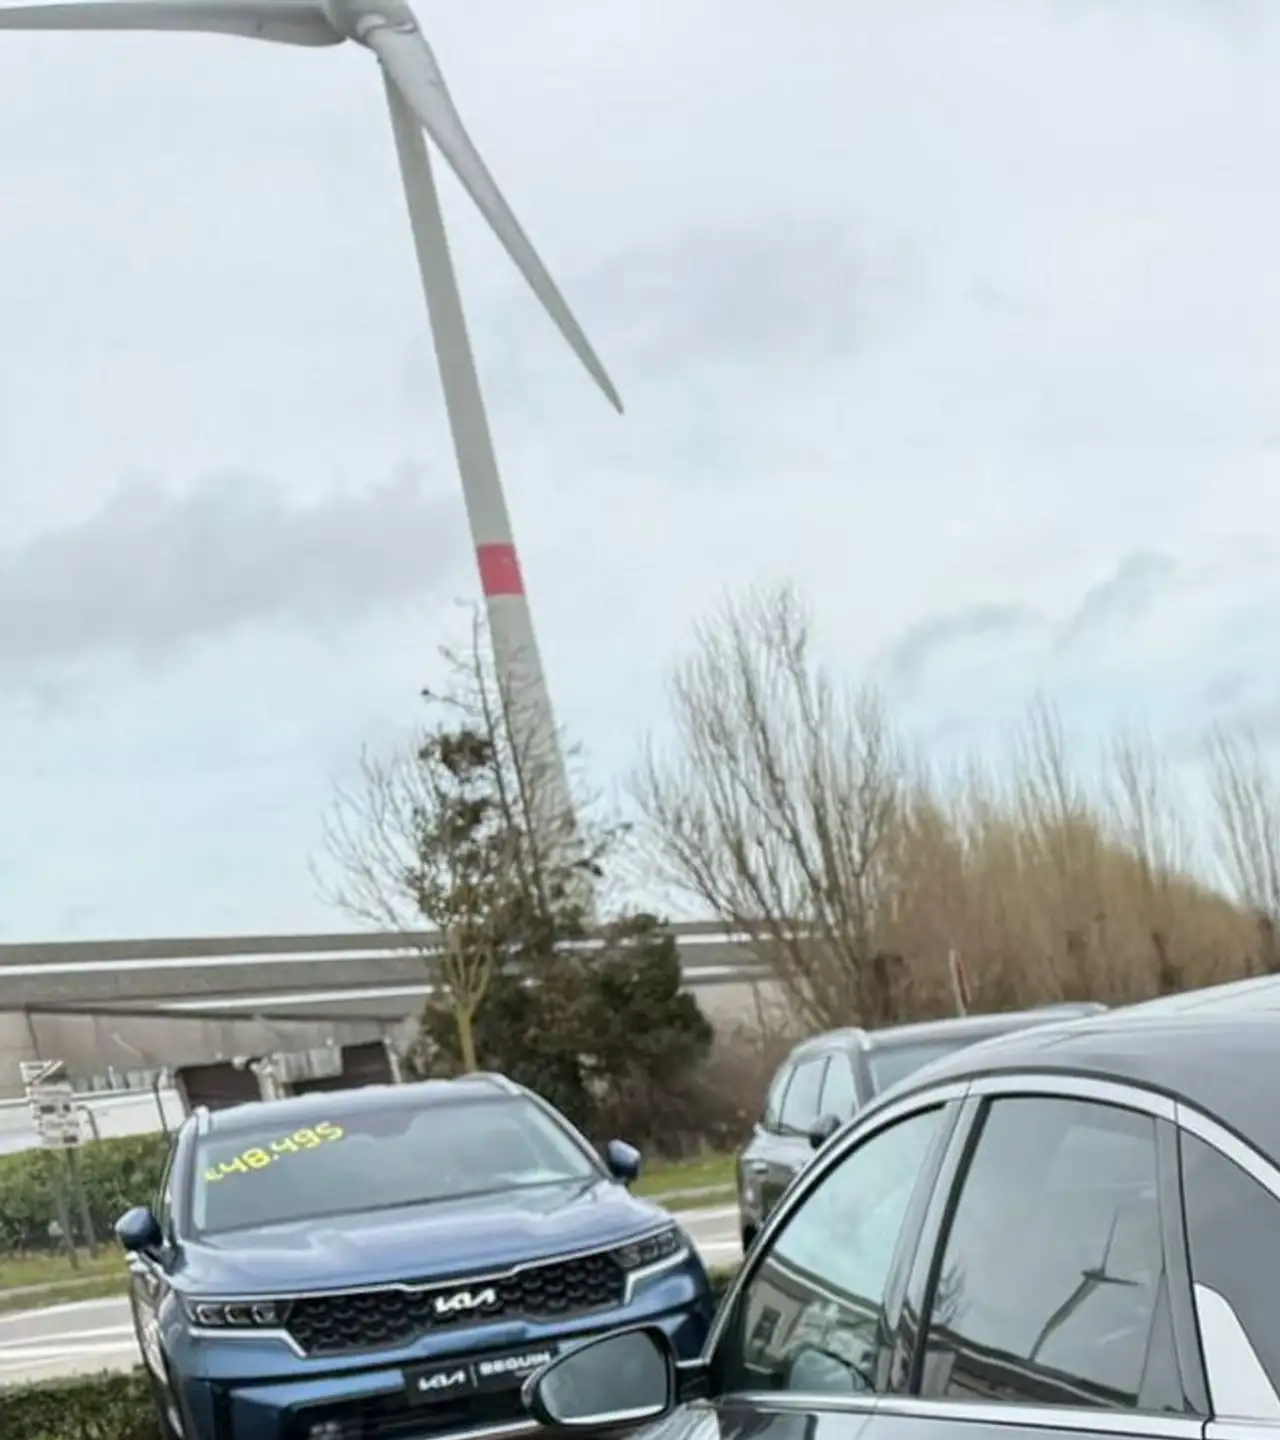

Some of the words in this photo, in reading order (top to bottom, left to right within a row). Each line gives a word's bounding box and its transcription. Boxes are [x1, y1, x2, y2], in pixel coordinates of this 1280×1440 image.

[433, 1287, 497, 1313] KIA
[418, 1369, 467, 1391] KIA
[479, 1351, 551, 1376] BEGUIN
